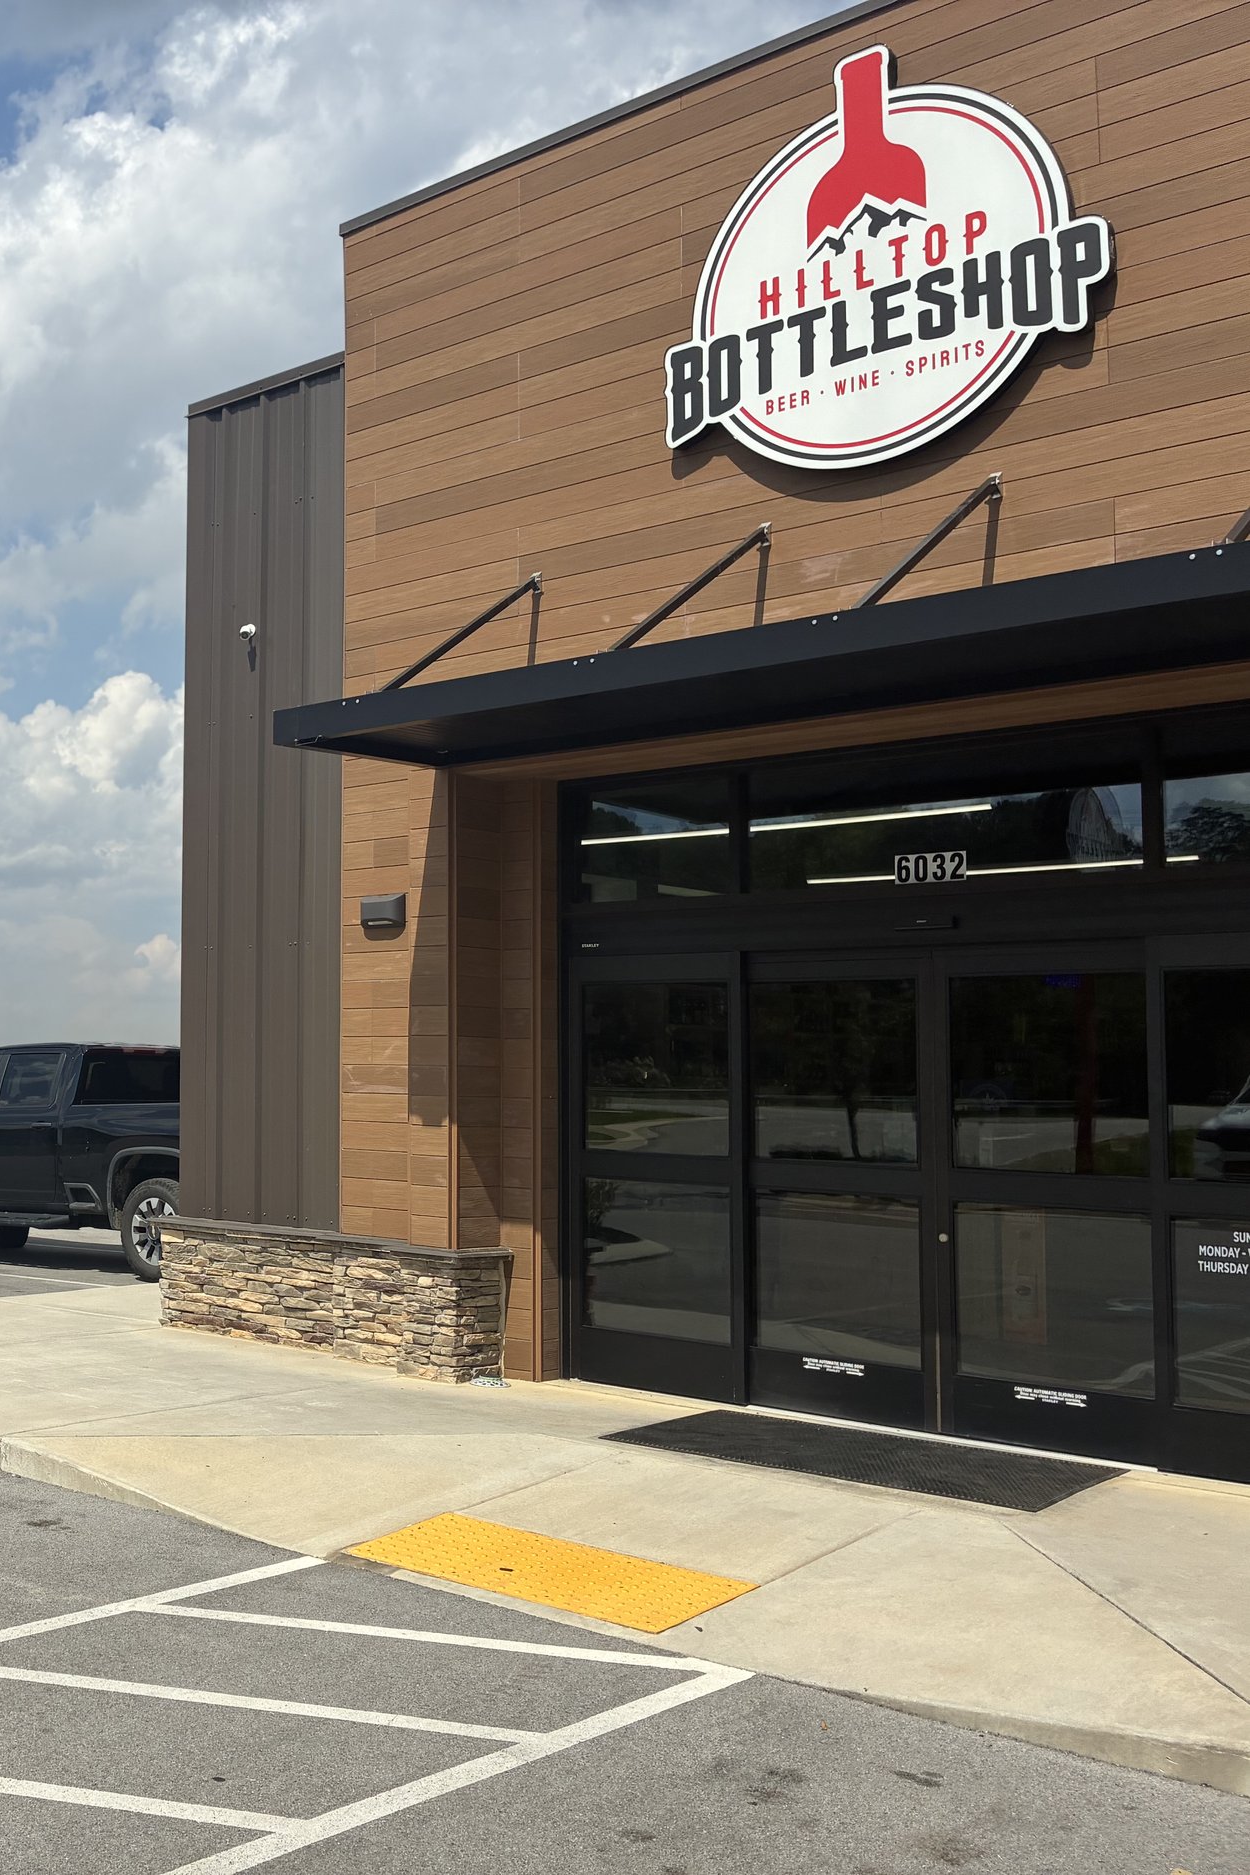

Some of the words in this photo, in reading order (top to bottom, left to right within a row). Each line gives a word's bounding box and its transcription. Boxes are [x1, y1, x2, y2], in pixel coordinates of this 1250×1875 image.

[758, 210, 988, 320] HILLTOP
[670, 222, 1103, 443] BOTTLESHOP
[766, 389, 810, 416] BEER
[834, 369, 880, 397] WINE
[904, 339, 986, 378] SPIRITS
[897, 852, 965, 883] 6032
[1197, 1260, 1249, 1275] THURSDAY
[1199, 1244, 1241, 1259] MONDAY
